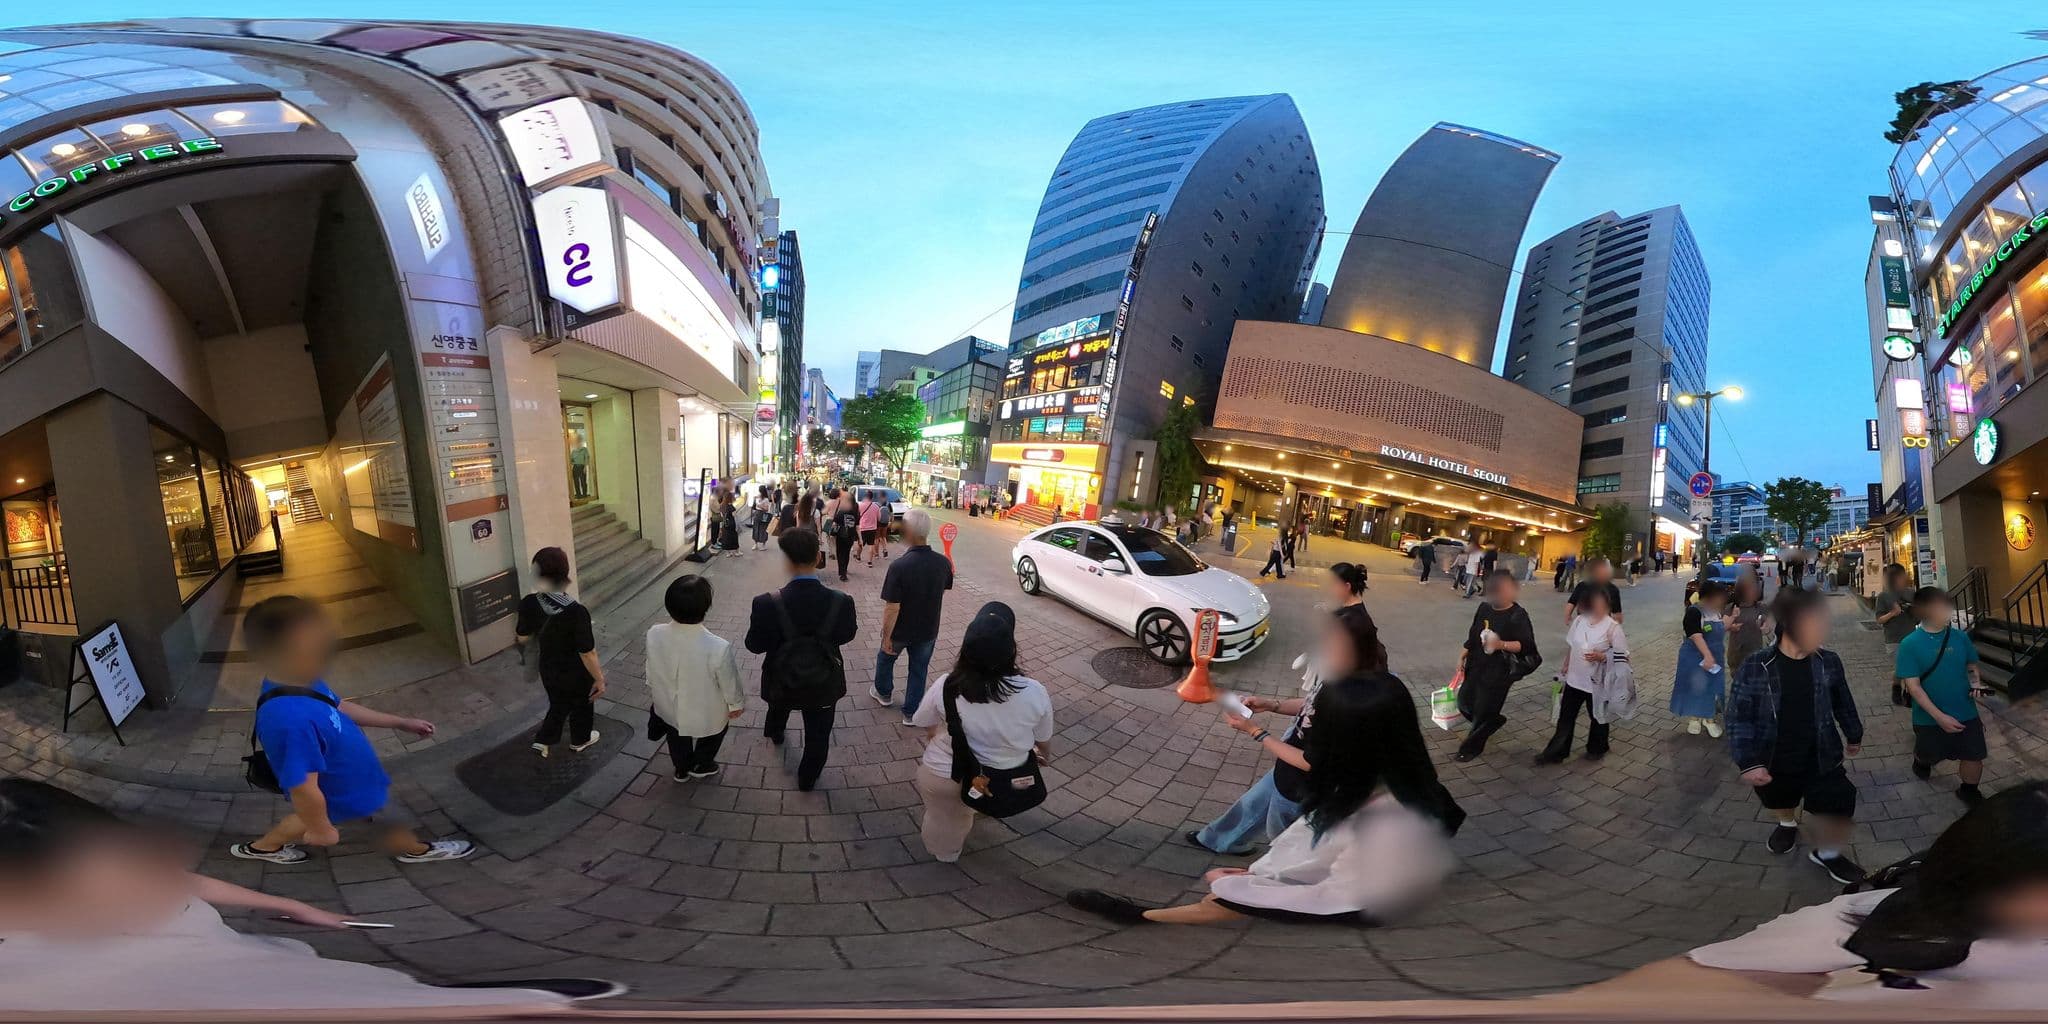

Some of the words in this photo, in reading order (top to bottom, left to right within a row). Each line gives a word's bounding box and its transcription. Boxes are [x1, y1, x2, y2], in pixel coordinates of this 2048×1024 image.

[9, 137, 225, 213] COFFEE
[563, 242, 593, 288] CU
[1937, 211, 2048, 340] STARBUCKS
[432, 334, 478, 351] 신영증권
[1381, 445, 1424, 463] ROYAL
[1429, 456, 1470, 476] HOTEL
[1473, 468, 1508, 485] SEOUL
[478, 528, 488, 538] 60
